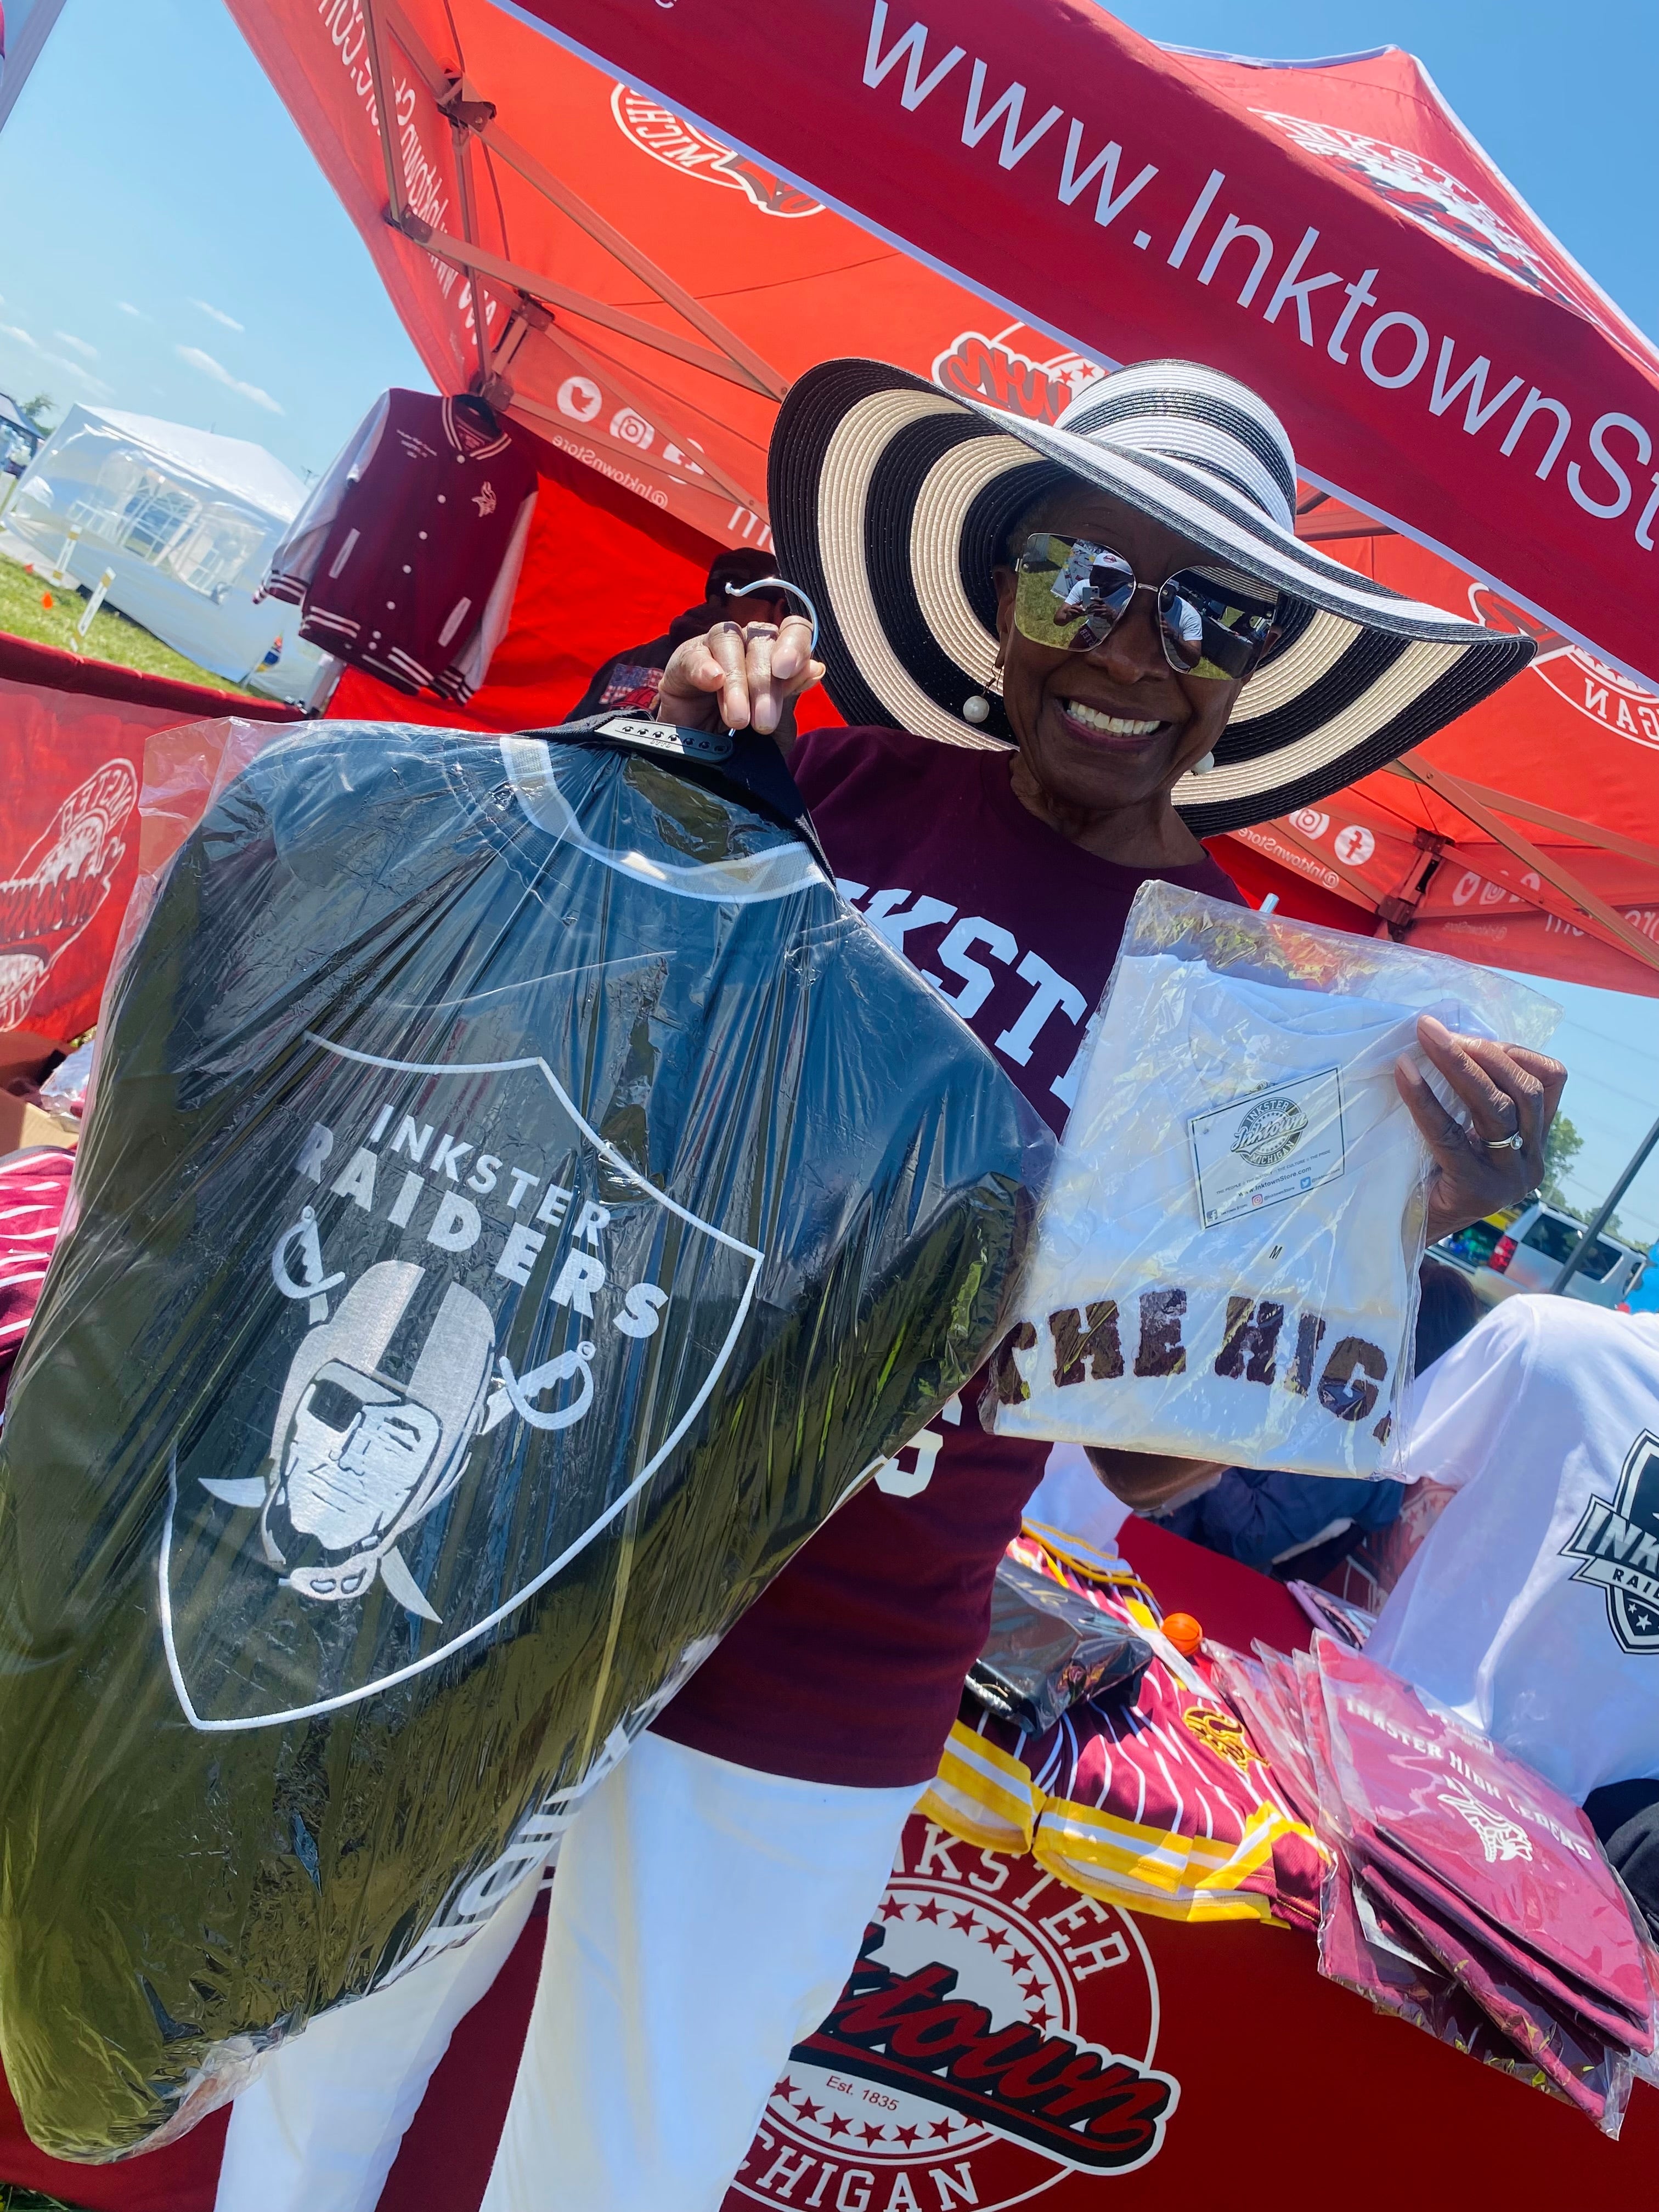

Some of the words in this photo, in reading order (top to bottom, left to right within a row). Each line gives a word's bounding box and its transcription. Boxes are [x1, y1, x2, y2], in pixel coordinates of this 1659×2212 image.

[1246, 1099, 1289, 1123] INKSTER
[1231, 1113, 1308, 1151] Inktown
[1250, 1141, 1295, 1164] MICHIGAN
[369, 1104, 611, 1247] INKSTER
[294, 1122, 669, 1339] RAIDERS
[892, 1823, 1131, 1982] KSTER
[826, 2074, 854, 2097] Est.
[862, 2089, 900, 2112] 1835
